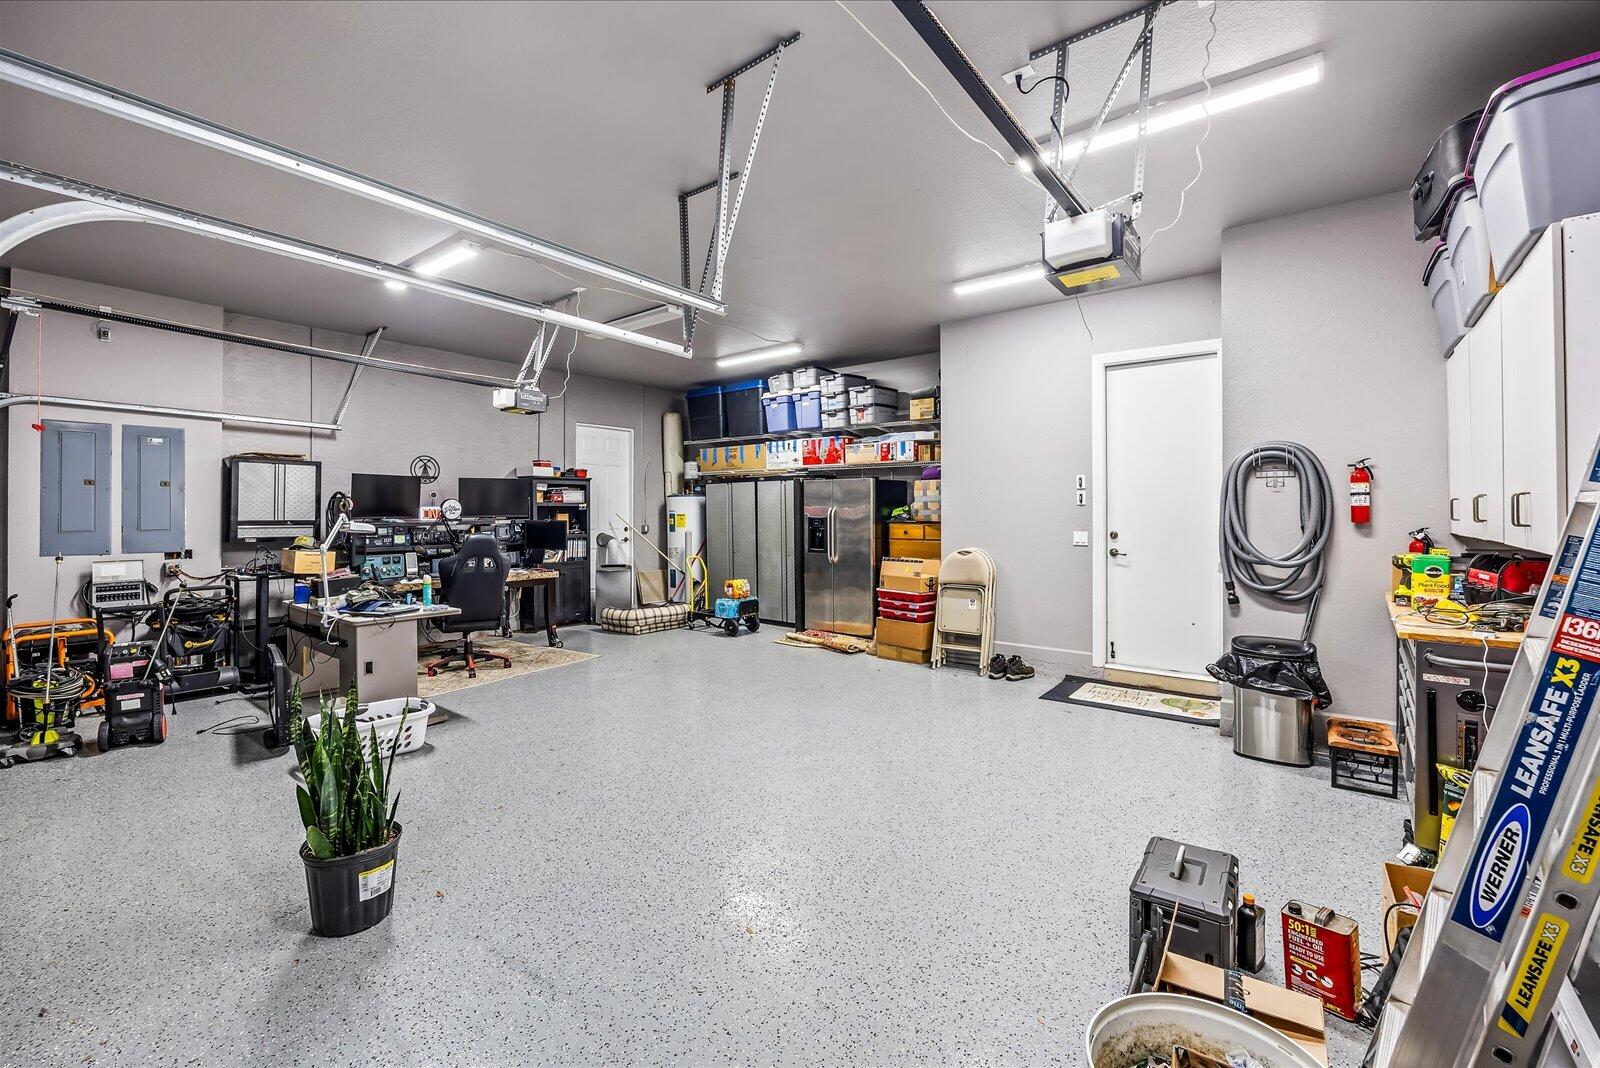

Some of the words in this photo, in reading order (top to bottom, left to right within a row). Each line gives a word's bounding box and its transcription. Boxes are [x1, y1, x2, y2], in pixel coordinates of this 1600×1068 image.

[1510, 687, 1569, 799] LEANSAFE
[1550, 656, 1581, 688] X3
[1539, 754, 1560, 795] PROFESSIONAL
[1560, 692, 1582, 739] MULTI-PURPOSE
[1578, 672, 1591, 696] LADDER
[1480, 827, 1520, 904] WERNER
[1570, 852, 1591, 875] X3
[1288, 918, 1310, 936] 50:1
[1288, 929, 1324, 946] ENGINEERED
[1288, 934, 1304, 946] FUEL
[1312, 943, 1324, 952] OIL
[1289, 943, 1306, 955] READY
[1307, 950, 1314, 958] TO
[1314, 954, 1325, 962] USE
[1515, 939, 1553, 1009] LEANSAFE
[1541, 921, 1561, 943] X3
